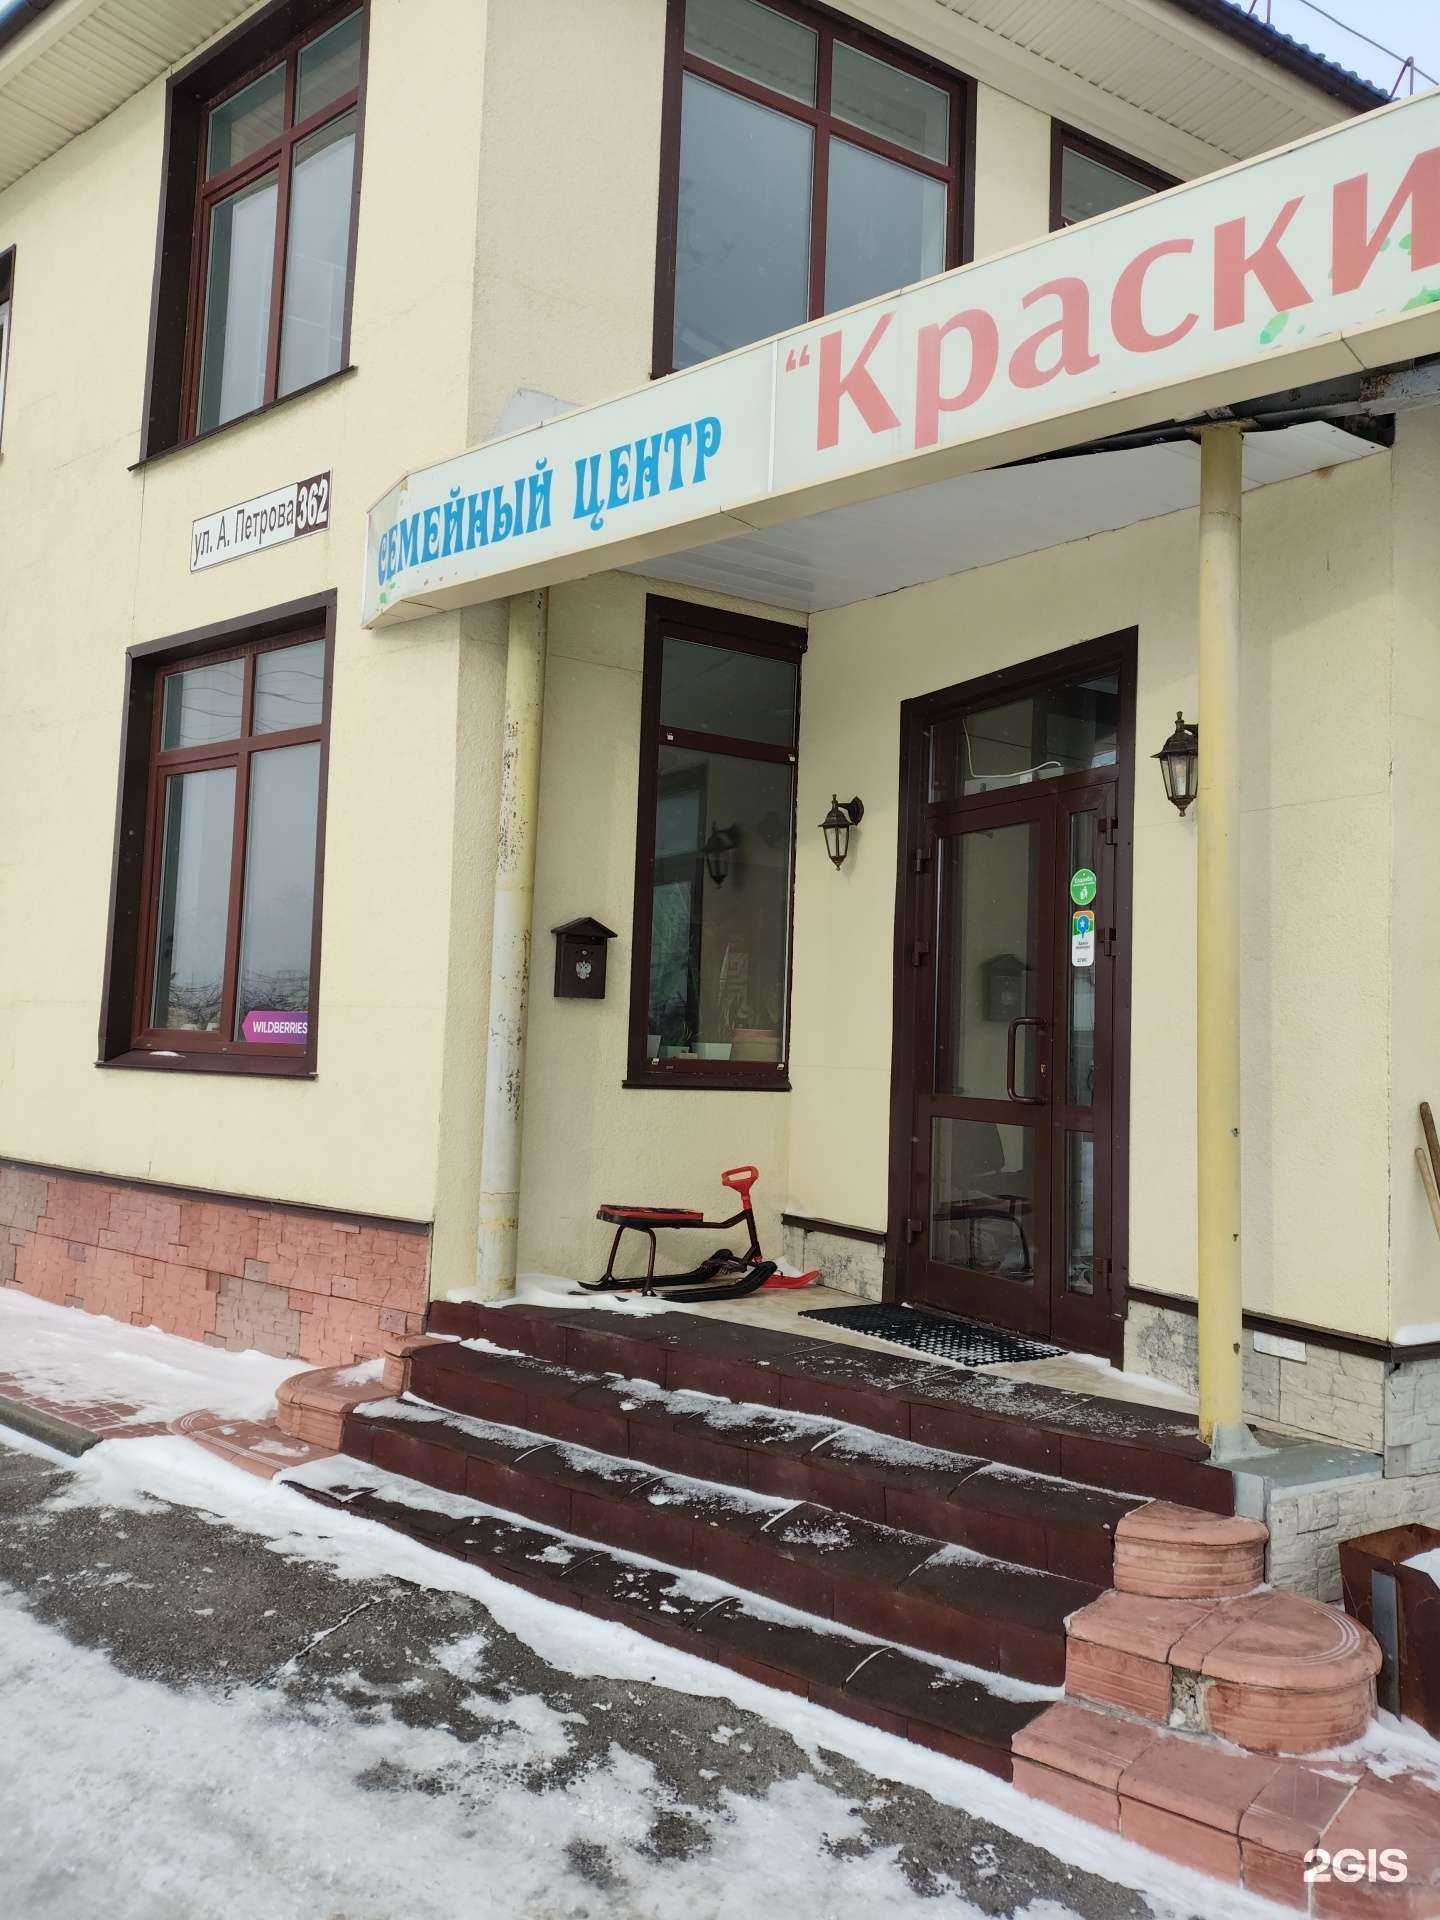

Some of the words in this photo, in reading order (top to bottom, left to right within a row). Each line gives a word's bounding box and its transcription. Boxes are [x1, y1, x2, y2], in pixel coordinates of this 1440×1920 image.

[193, 529, 213, 567] ул.
[216, 515, 230, 551] А.
[234, 499, 294, 545] Петрова
[296, 478, 329, 530] 362
[378, 457, 554, 587] СЕМЕЙНЫЙ
[573, 416, 722, 531] ЦЕНТР
[252, 1021, 308, 1034] WILDBERRIES
